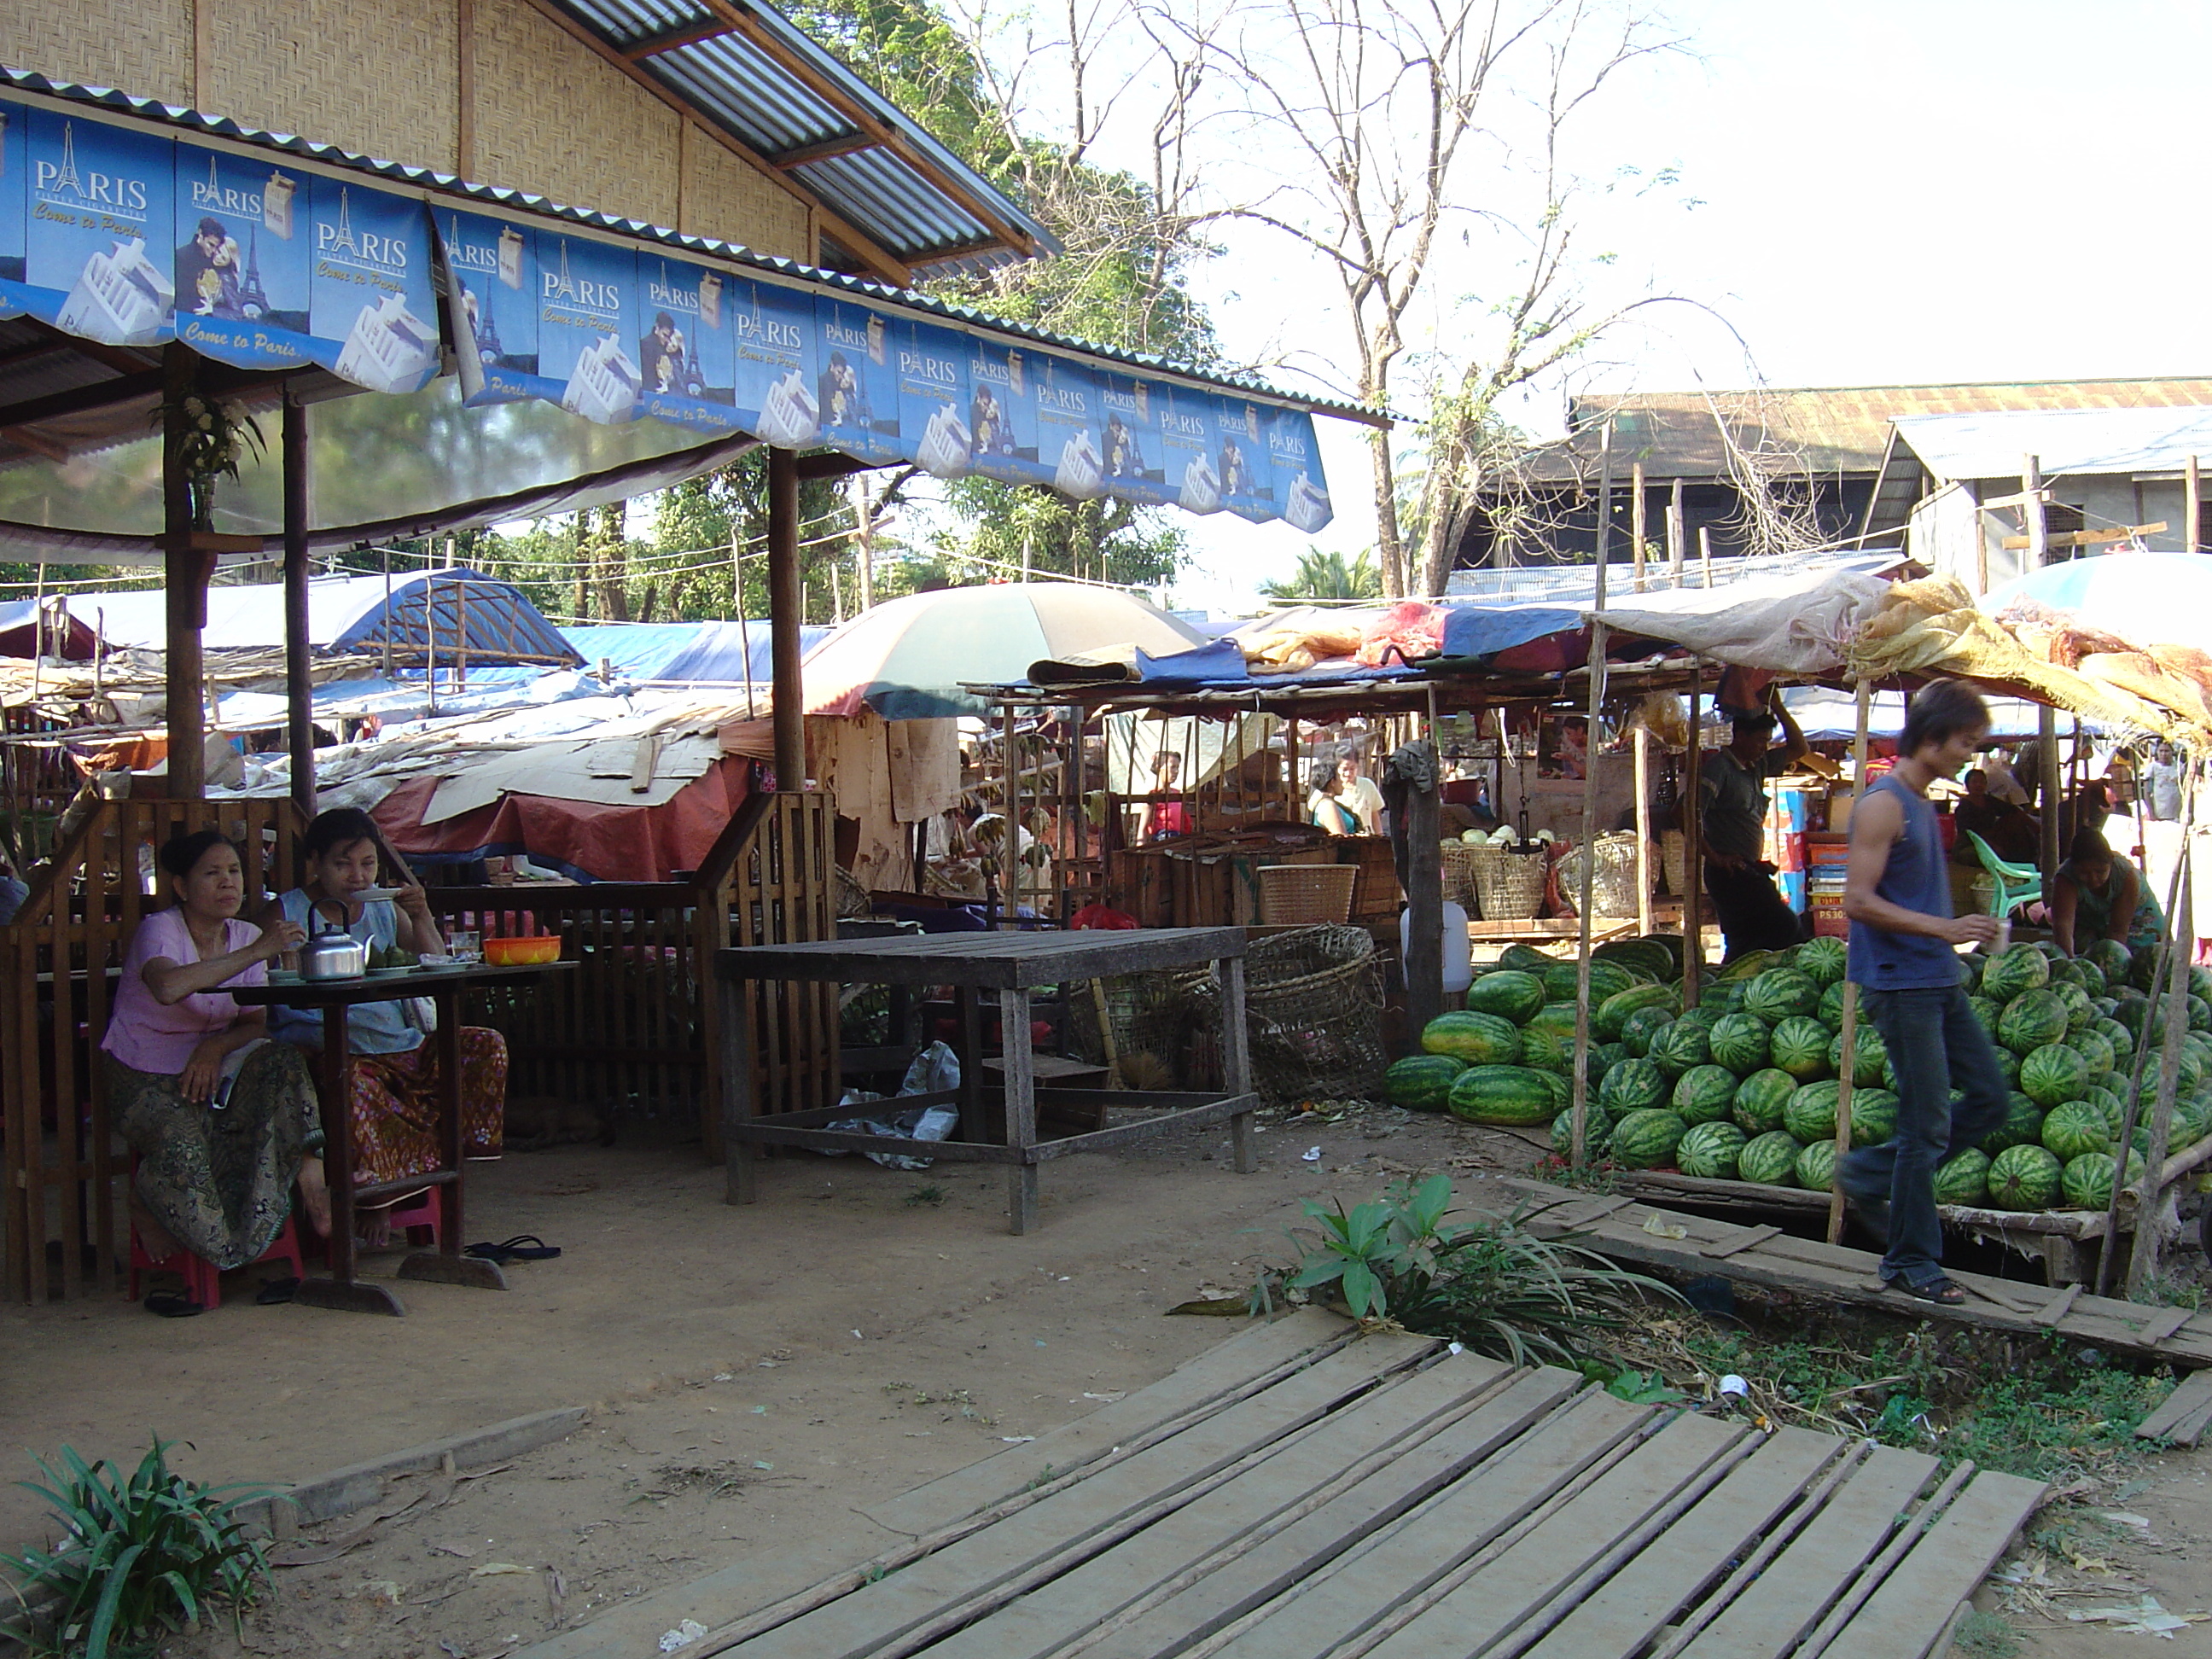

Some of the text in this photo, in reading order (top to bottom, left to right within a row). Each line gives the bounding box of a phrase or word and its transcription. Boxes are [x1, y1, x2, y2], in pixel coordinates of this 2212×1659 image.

[35, 121, 147, 210] PARIS
[191, 155, 261, 214] PARIS
[32, 202, 76, 224] Come
[81, 216, 96, 229] to
[35, 190, 73, 205] FILTER
[317, 186, 407, 269] PARIS
[443, 215, 497, 266] ARIS
[316, 260, 351, 282] Come
[353, 271, 367, 285] to
[543, 238, 620, 310] PARIS
[649, 260, 698, 308] PARIS
[542, 306, 572, 325] Come
[575, 317, 585, 328] to
[736, 283, 801, 348] PARIS
[825, 304, 867, 346] PARIS
[185, 322, 301, 358] Come to Paris.
[737, 346, 763, 363] Come
[899, 323, 956, 382] PARIS
[972, 341, 1010, 381] PARIS
[1037, 358, 1086, 411] PARIS
[1103, 373, 1136, 409] PARIS
[651, 399, 680, 418] Come
[684, 410, 695, 420] to
[1161, 386, 1204, 436] PARIS
[1219, 399, 1247, 431] PARIS
[826, 431, 854, 449] Come
[1269, 410, 1305, 455] PARIS
